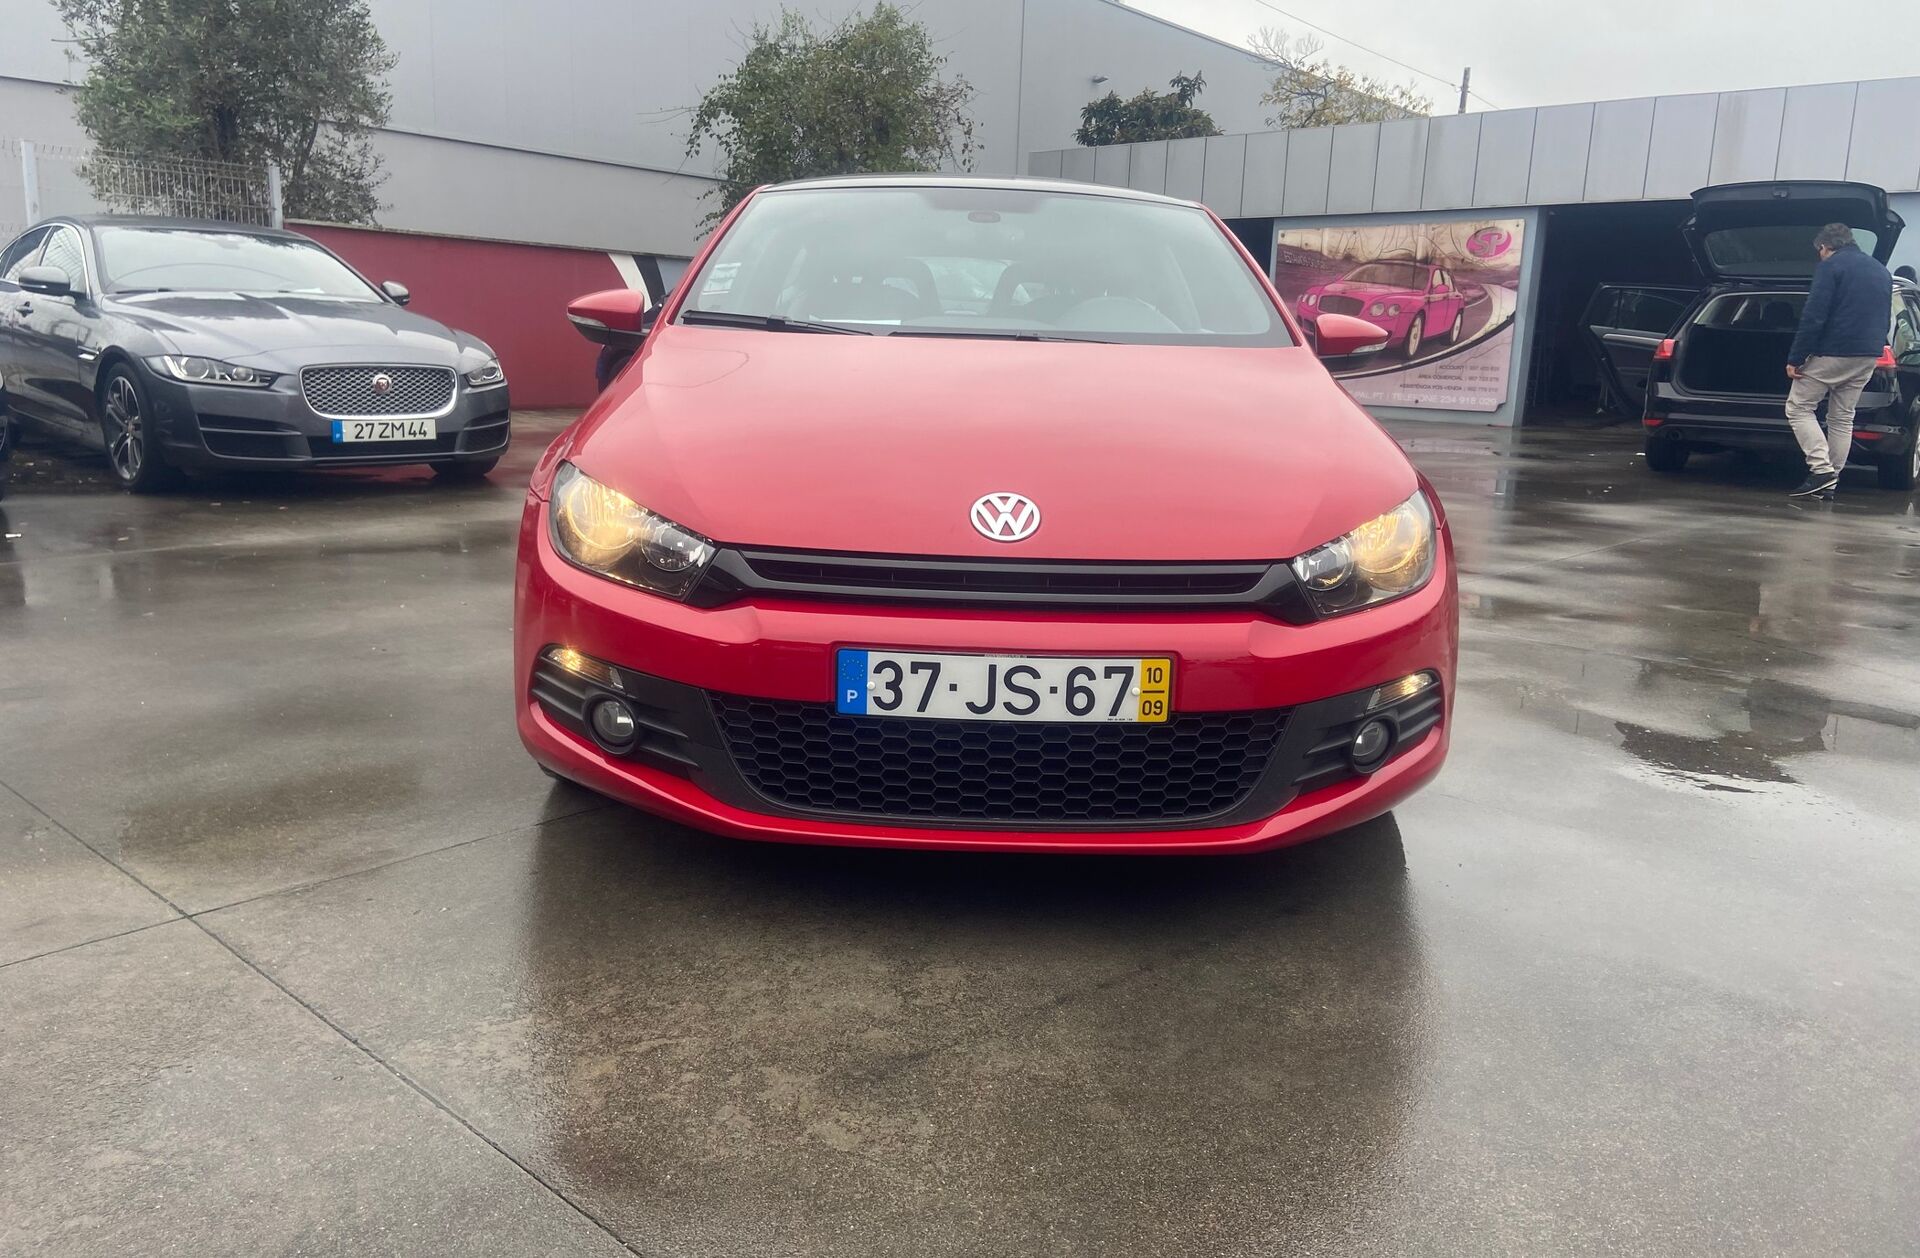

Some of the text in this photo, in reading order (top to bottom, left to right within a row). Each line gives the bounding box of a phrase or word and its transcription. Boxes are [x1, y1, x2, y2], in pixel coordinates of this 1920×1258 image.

[1146, 666, 1163, 684] 10
[846, 689, 858, 703] P
[1141, 700, 1164, 717] 09
